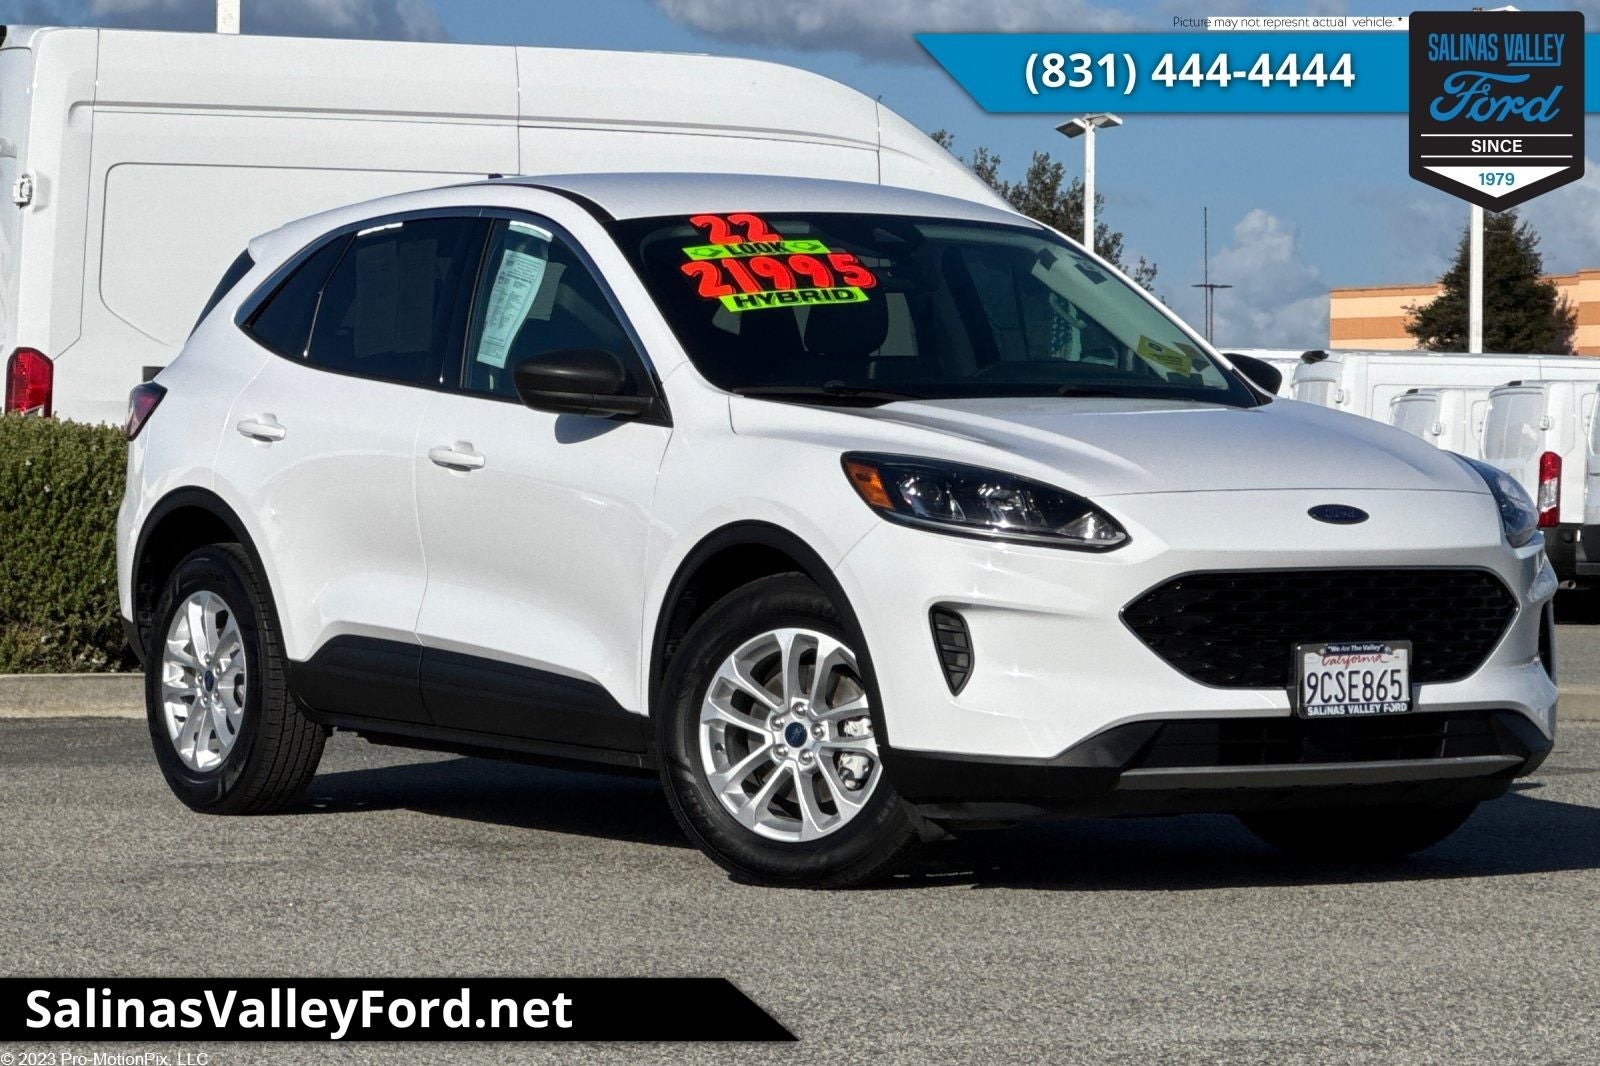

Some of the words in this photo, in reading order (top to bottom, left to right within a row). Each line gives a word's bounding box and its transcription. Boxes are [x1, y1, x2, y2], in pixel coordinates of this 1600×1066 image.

[689, 213, 784, 246] 22
[724, 241, 787, 256] LOOK
[680, 253, 877, 298] 21995
[734, 289, 858, 308] HYBRID
[1306, 669, 1403, 705] 9CSE865
[1307, 705, 1346, 716] SALINAS
[1348, 704, 1382, 714] VALLEY
[1384, 702, 1408, 712] FORD
